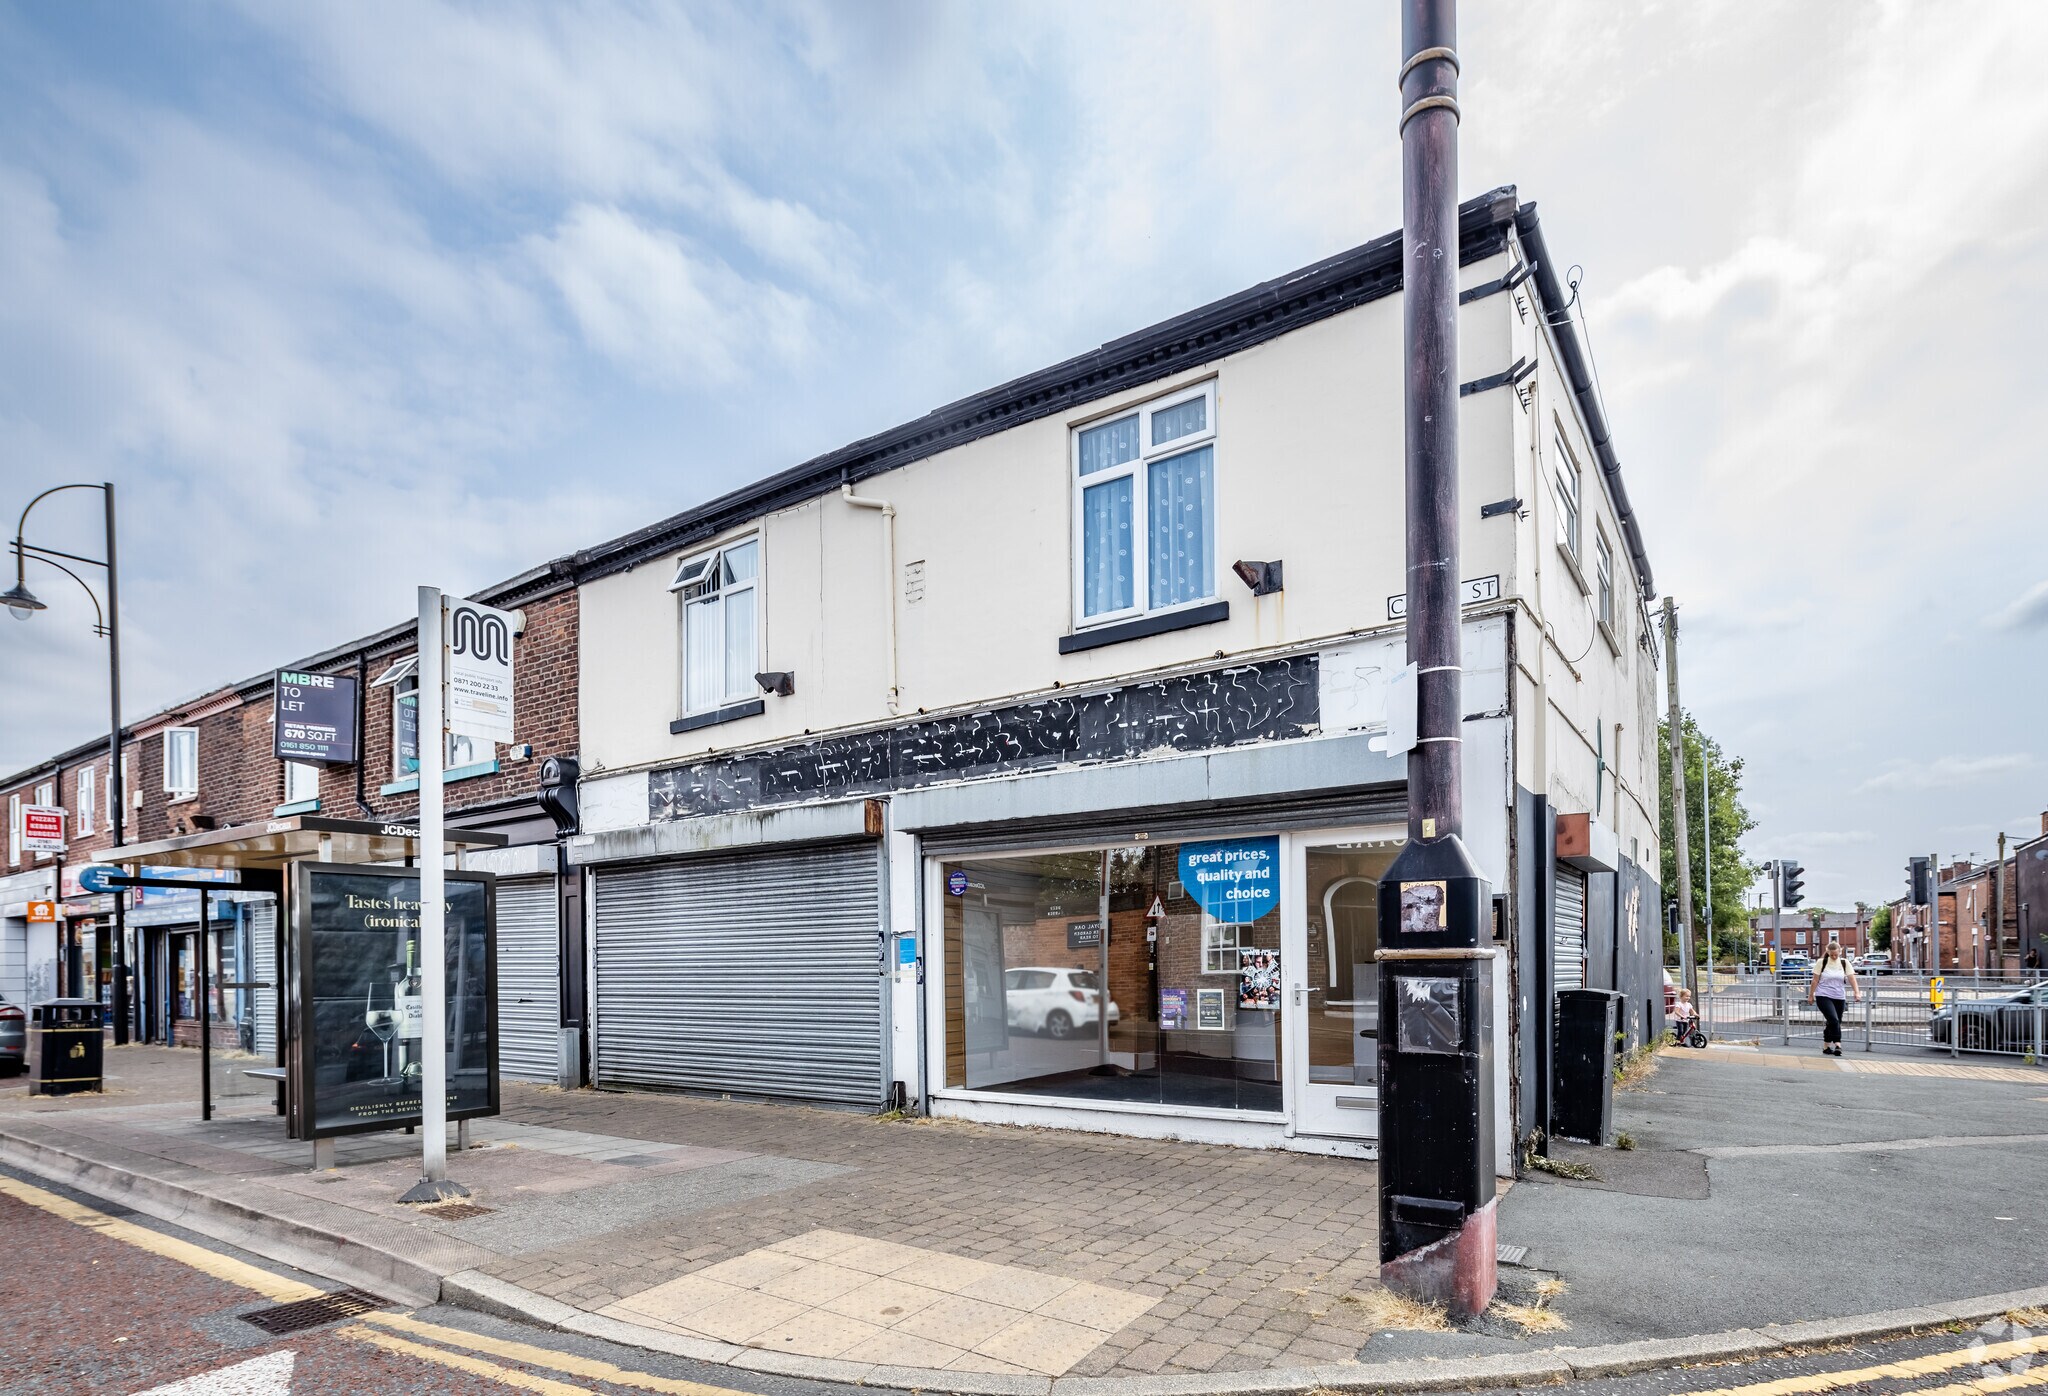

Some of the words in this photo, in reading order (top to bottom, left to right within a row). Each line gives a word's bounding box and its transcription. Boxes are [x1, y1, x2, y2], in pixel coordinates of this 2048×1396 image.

[1472, 580, 1496, 598] ST
[281, 672, 335, 688] MBRE
[453, 677, 469, 685] 0871
[469, 680, 482, 688] 200
[281, 686, 301, 698] TO
[453, 686, 508, 702] www.traveline.info
[281, 700, 305, 712] LET
[284, 729, 306, 739] 670
[307, 731, 337, 742] SQ.FT
[306, 725, 337, 733] PREMISES
[281, 741, 298, 749] 0161
[1188, 851, 1222, 867] great
[1224, 849, 1270, 865] prices,
[1196, 869, 1243, 884] quality
[1244, 866, 1270, 879] and
[1225, 886, 1271, 899] choice
[345, 894, 392, 909] Tastes
[350, 1103, 393, 1111] DEVILISHLY
